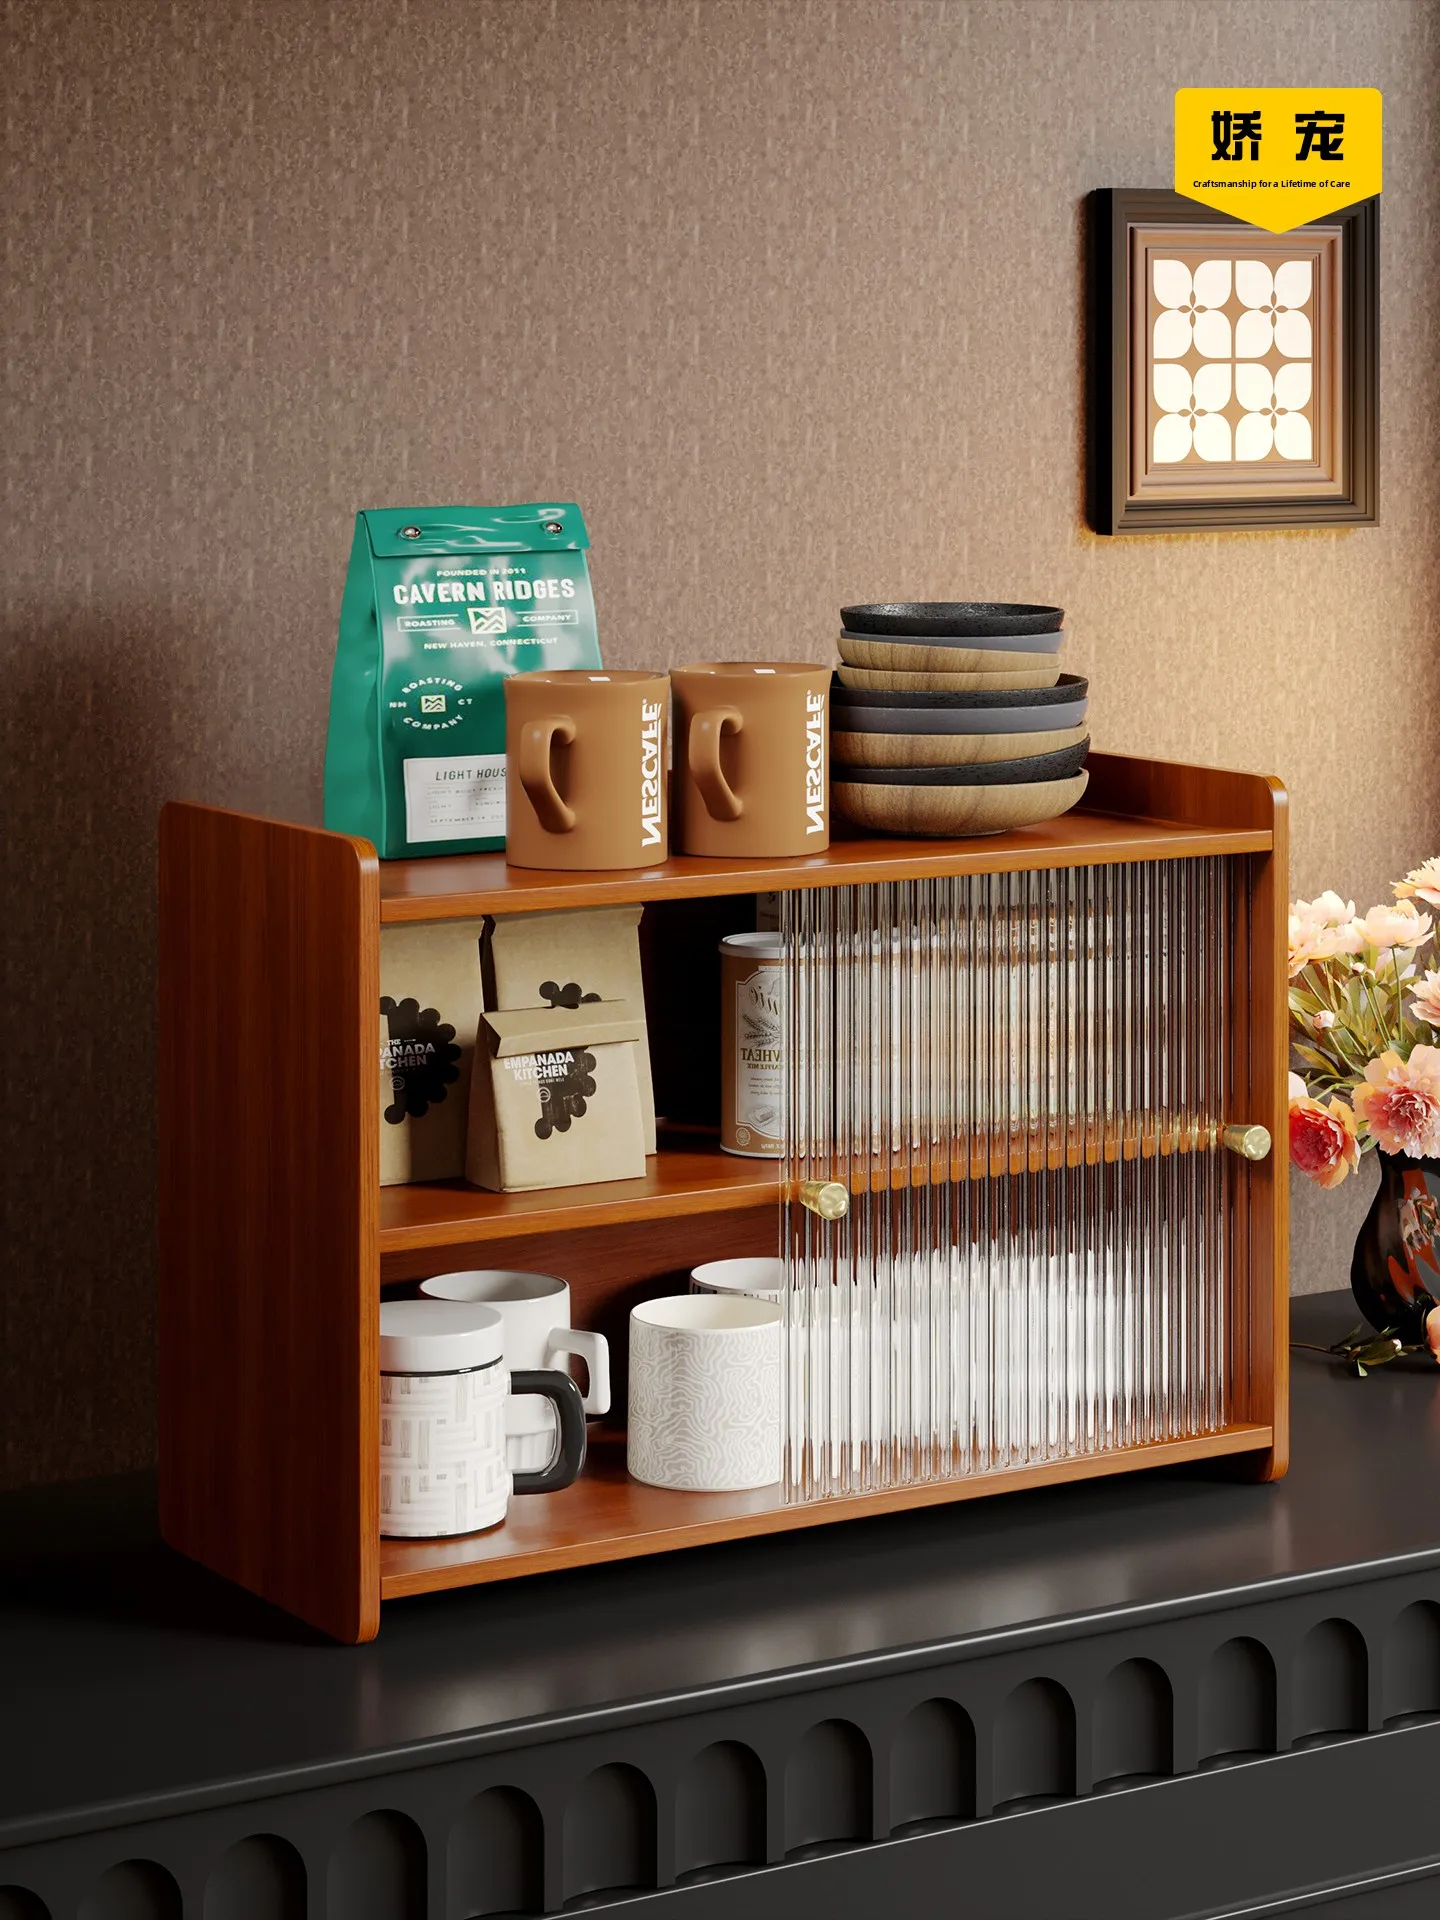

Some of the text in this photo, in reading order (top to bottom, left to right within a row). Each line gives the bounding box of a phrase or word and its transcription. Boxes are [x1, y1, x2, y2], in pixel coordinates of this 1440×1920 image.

[436, 569, 487, 577] FOUNDED
[393, 578, 576, 605] CAVERN RIDGES
[404, 618, 456, 629] ROASTING
[522, 613, 572, 623] COMPANY
[423, 637, 558, 650] NEW HAVEN, CONNECTICUT
[401, 677, 463, 694] ROASTING
[457, 698, 473, 706] CT
[402, 714, 464, 731] COMPANY
[435, 769, 472, 781] LIGHT
[387, 1038, 401, 1046] THE
[503, 1050, 575, 1070] EMPANADA
[513, 1063, 568, 1081] KITCHEN
